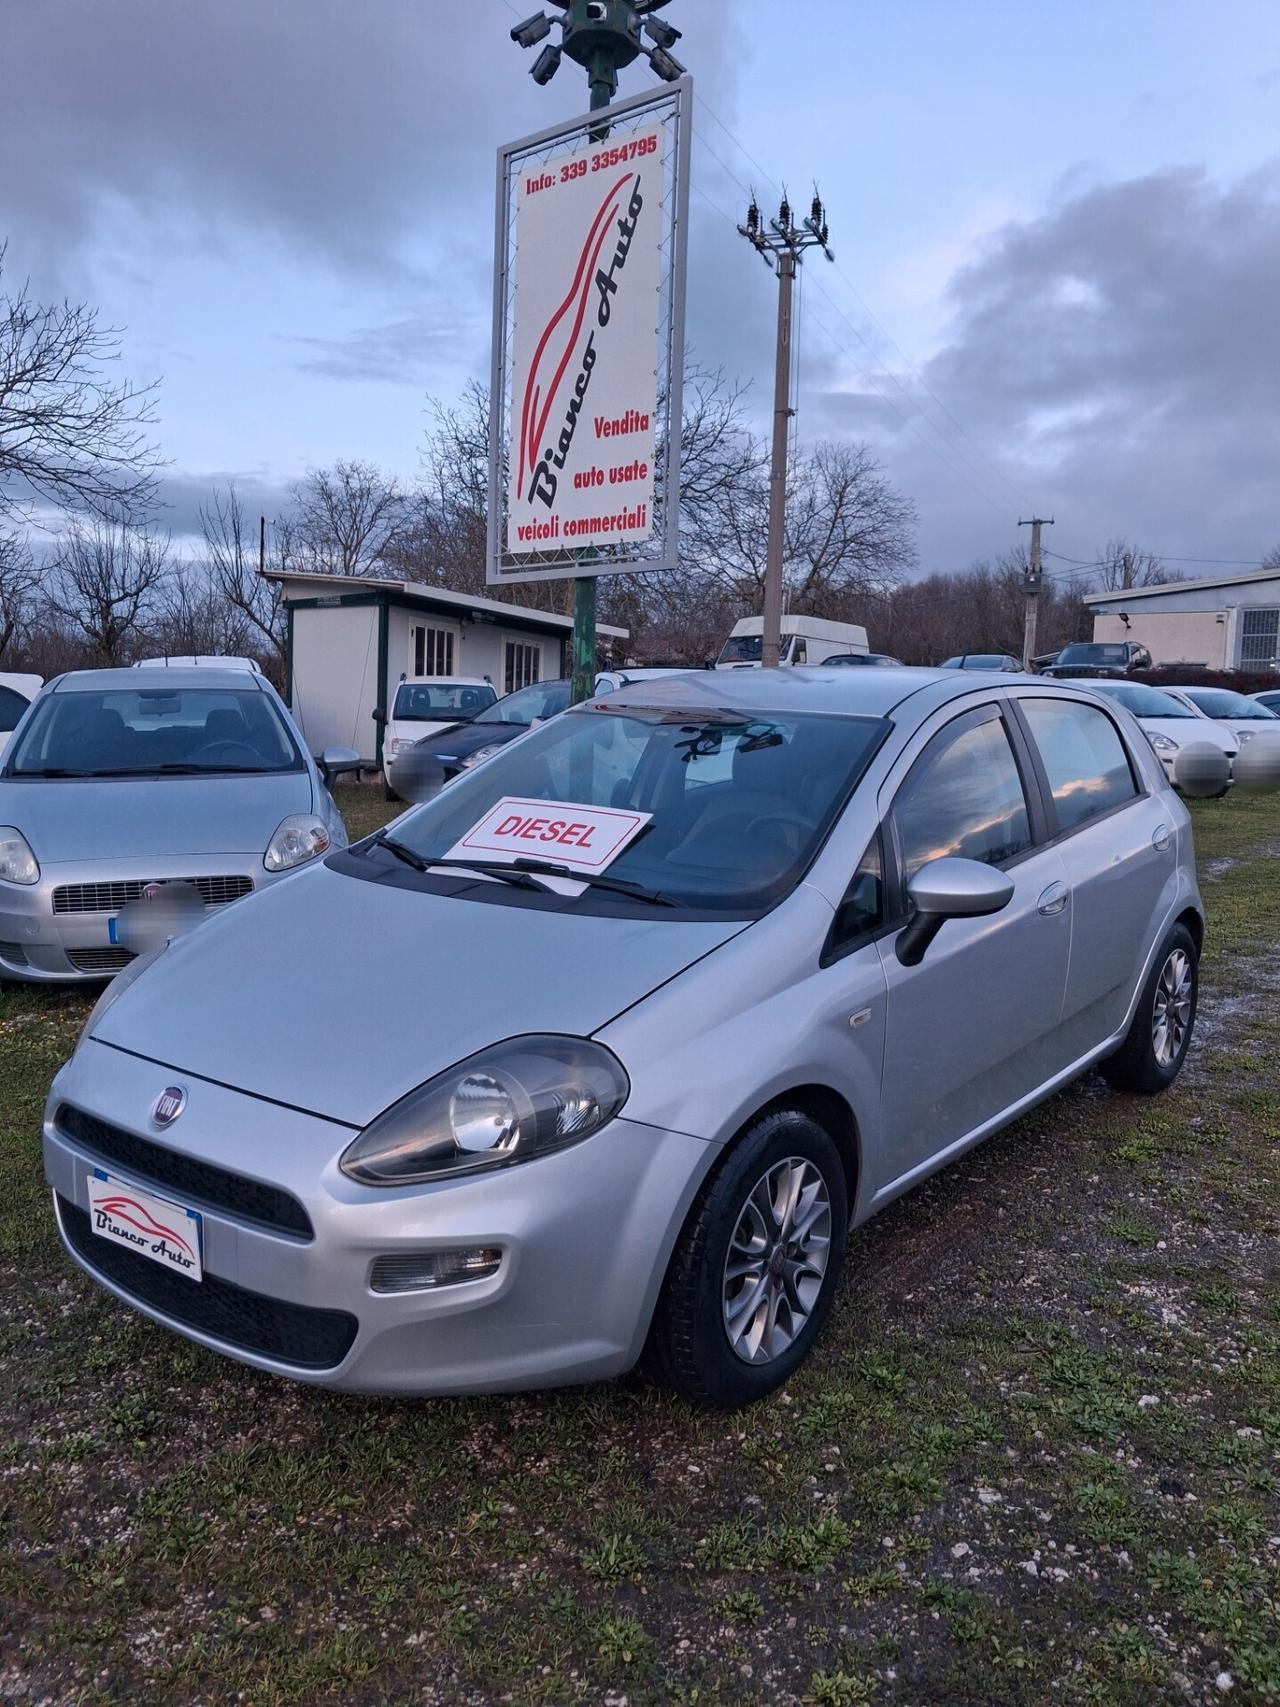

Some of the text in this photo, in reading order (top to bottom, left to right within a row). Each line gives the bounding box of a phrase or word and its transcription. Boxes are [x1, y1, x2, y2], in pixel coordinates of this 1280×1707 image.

[526, 135, 657, 194] Info: 339 3354795
[527, 174, 643, 509] Bianco Auto
[594, 409, 649, 438] Vendita
[573, 460, 648, 489] auto usate
[517, 504, 647, 541] veicoli commerciali
[494, 816, 597, 849] DIESEL
[157, 1094, 180, 1118] FIAT
[94, 1208, 195, 1268] Bianco Auto
